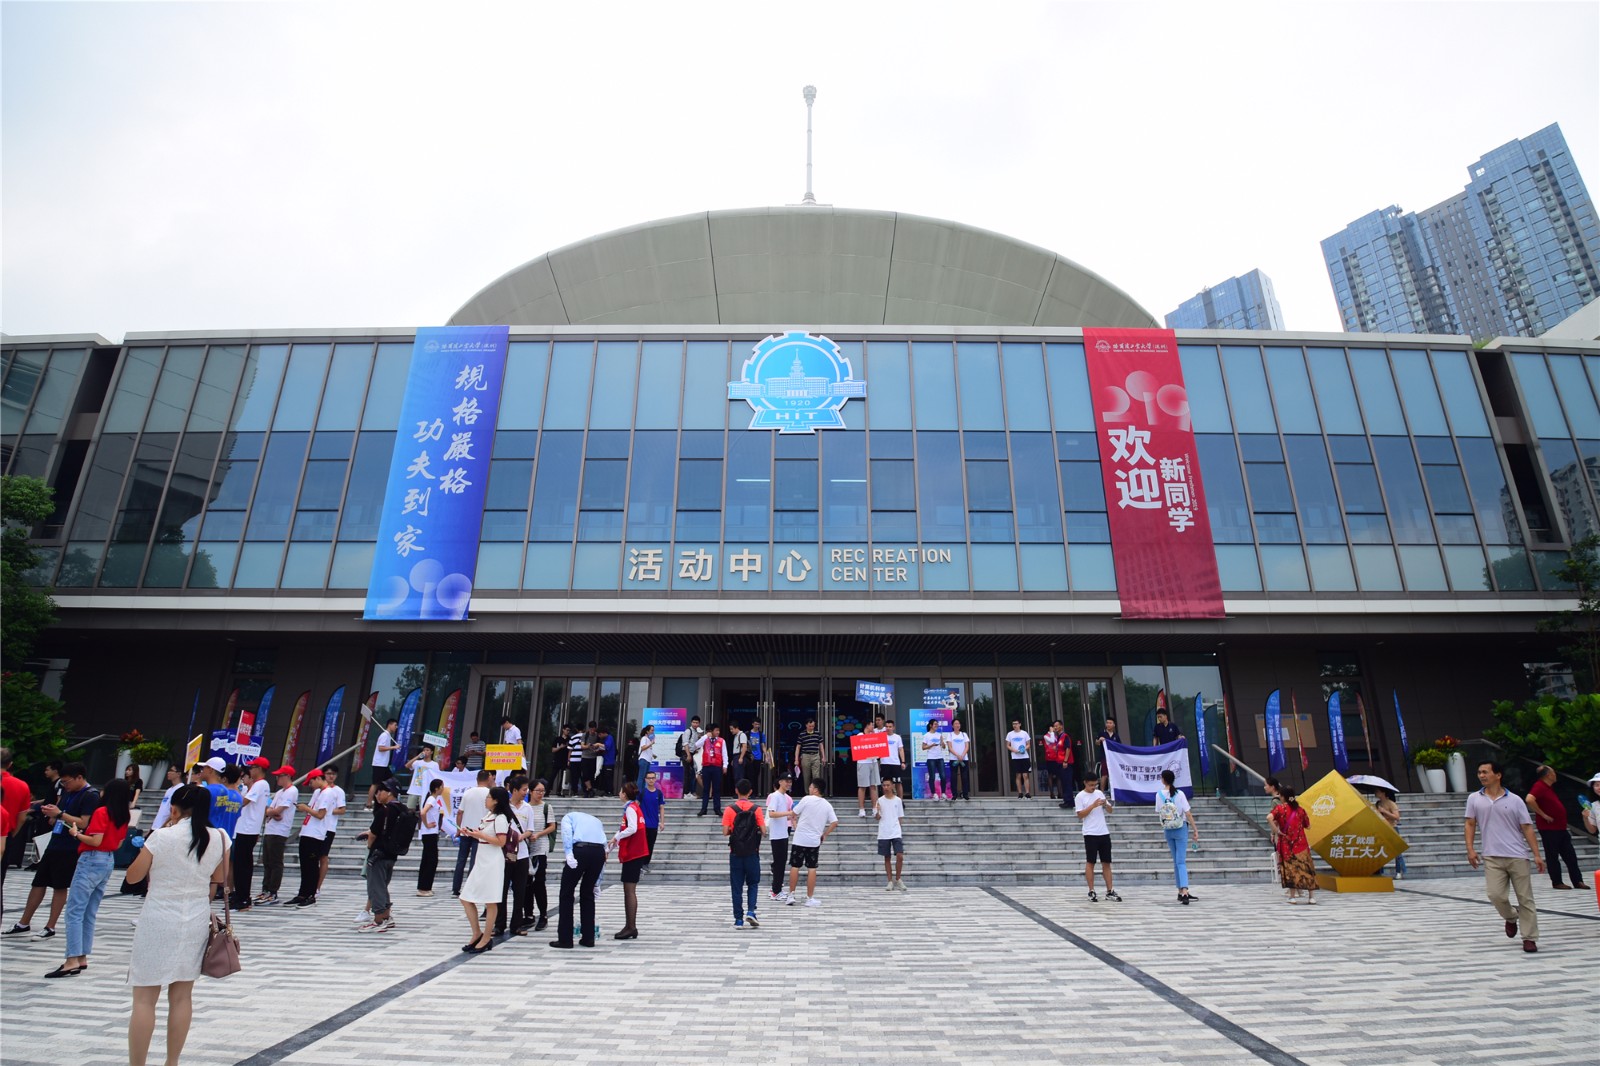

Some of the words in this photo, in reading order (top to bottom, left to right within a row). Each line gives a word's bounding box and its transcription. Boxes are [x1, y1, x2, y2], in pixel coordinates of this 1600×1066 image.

[775, 412, 818, 420] HIT
[1107, 424, 1163, 510] 欢迎
[392, 417, 445, 559] 功夫到家
[1158, 456, 1195, 533] 新同学
[628, 547, 812, 582] 活动中心
[831, 567, 908, 582] CENTER
[1331, 834, 1375, 845] 来了就是
[1329, 846, 1388, 859] 哈工大人
